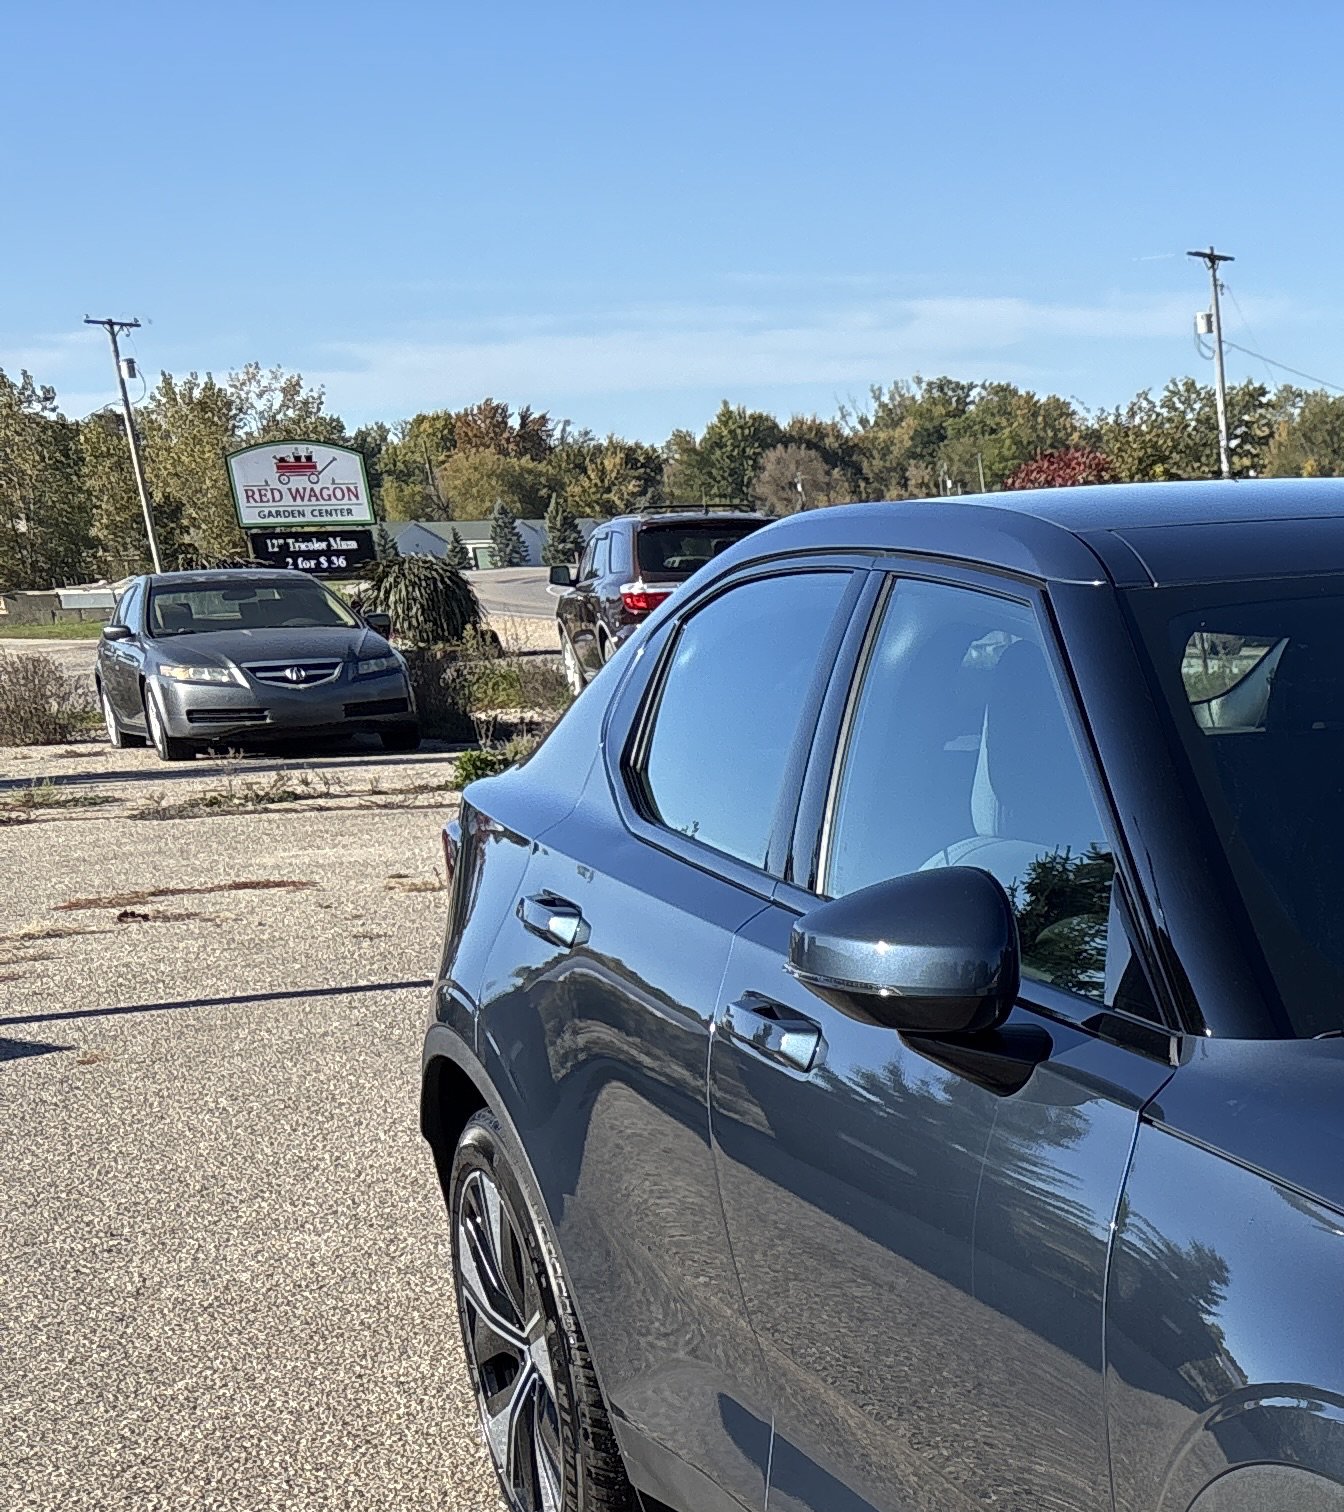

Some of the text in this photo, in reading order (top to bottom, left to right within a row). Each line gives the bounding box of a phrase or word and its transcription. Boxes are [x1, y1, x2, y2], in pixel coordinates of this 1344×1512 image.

[244, 486, 360, 504] RED WAGON
[258, 508, 353, 519] GARDEN CENTER
[286, 557, 294, 569] 2
[298, 557, 317, 569] for
[331, 555, 347, 568] 36
